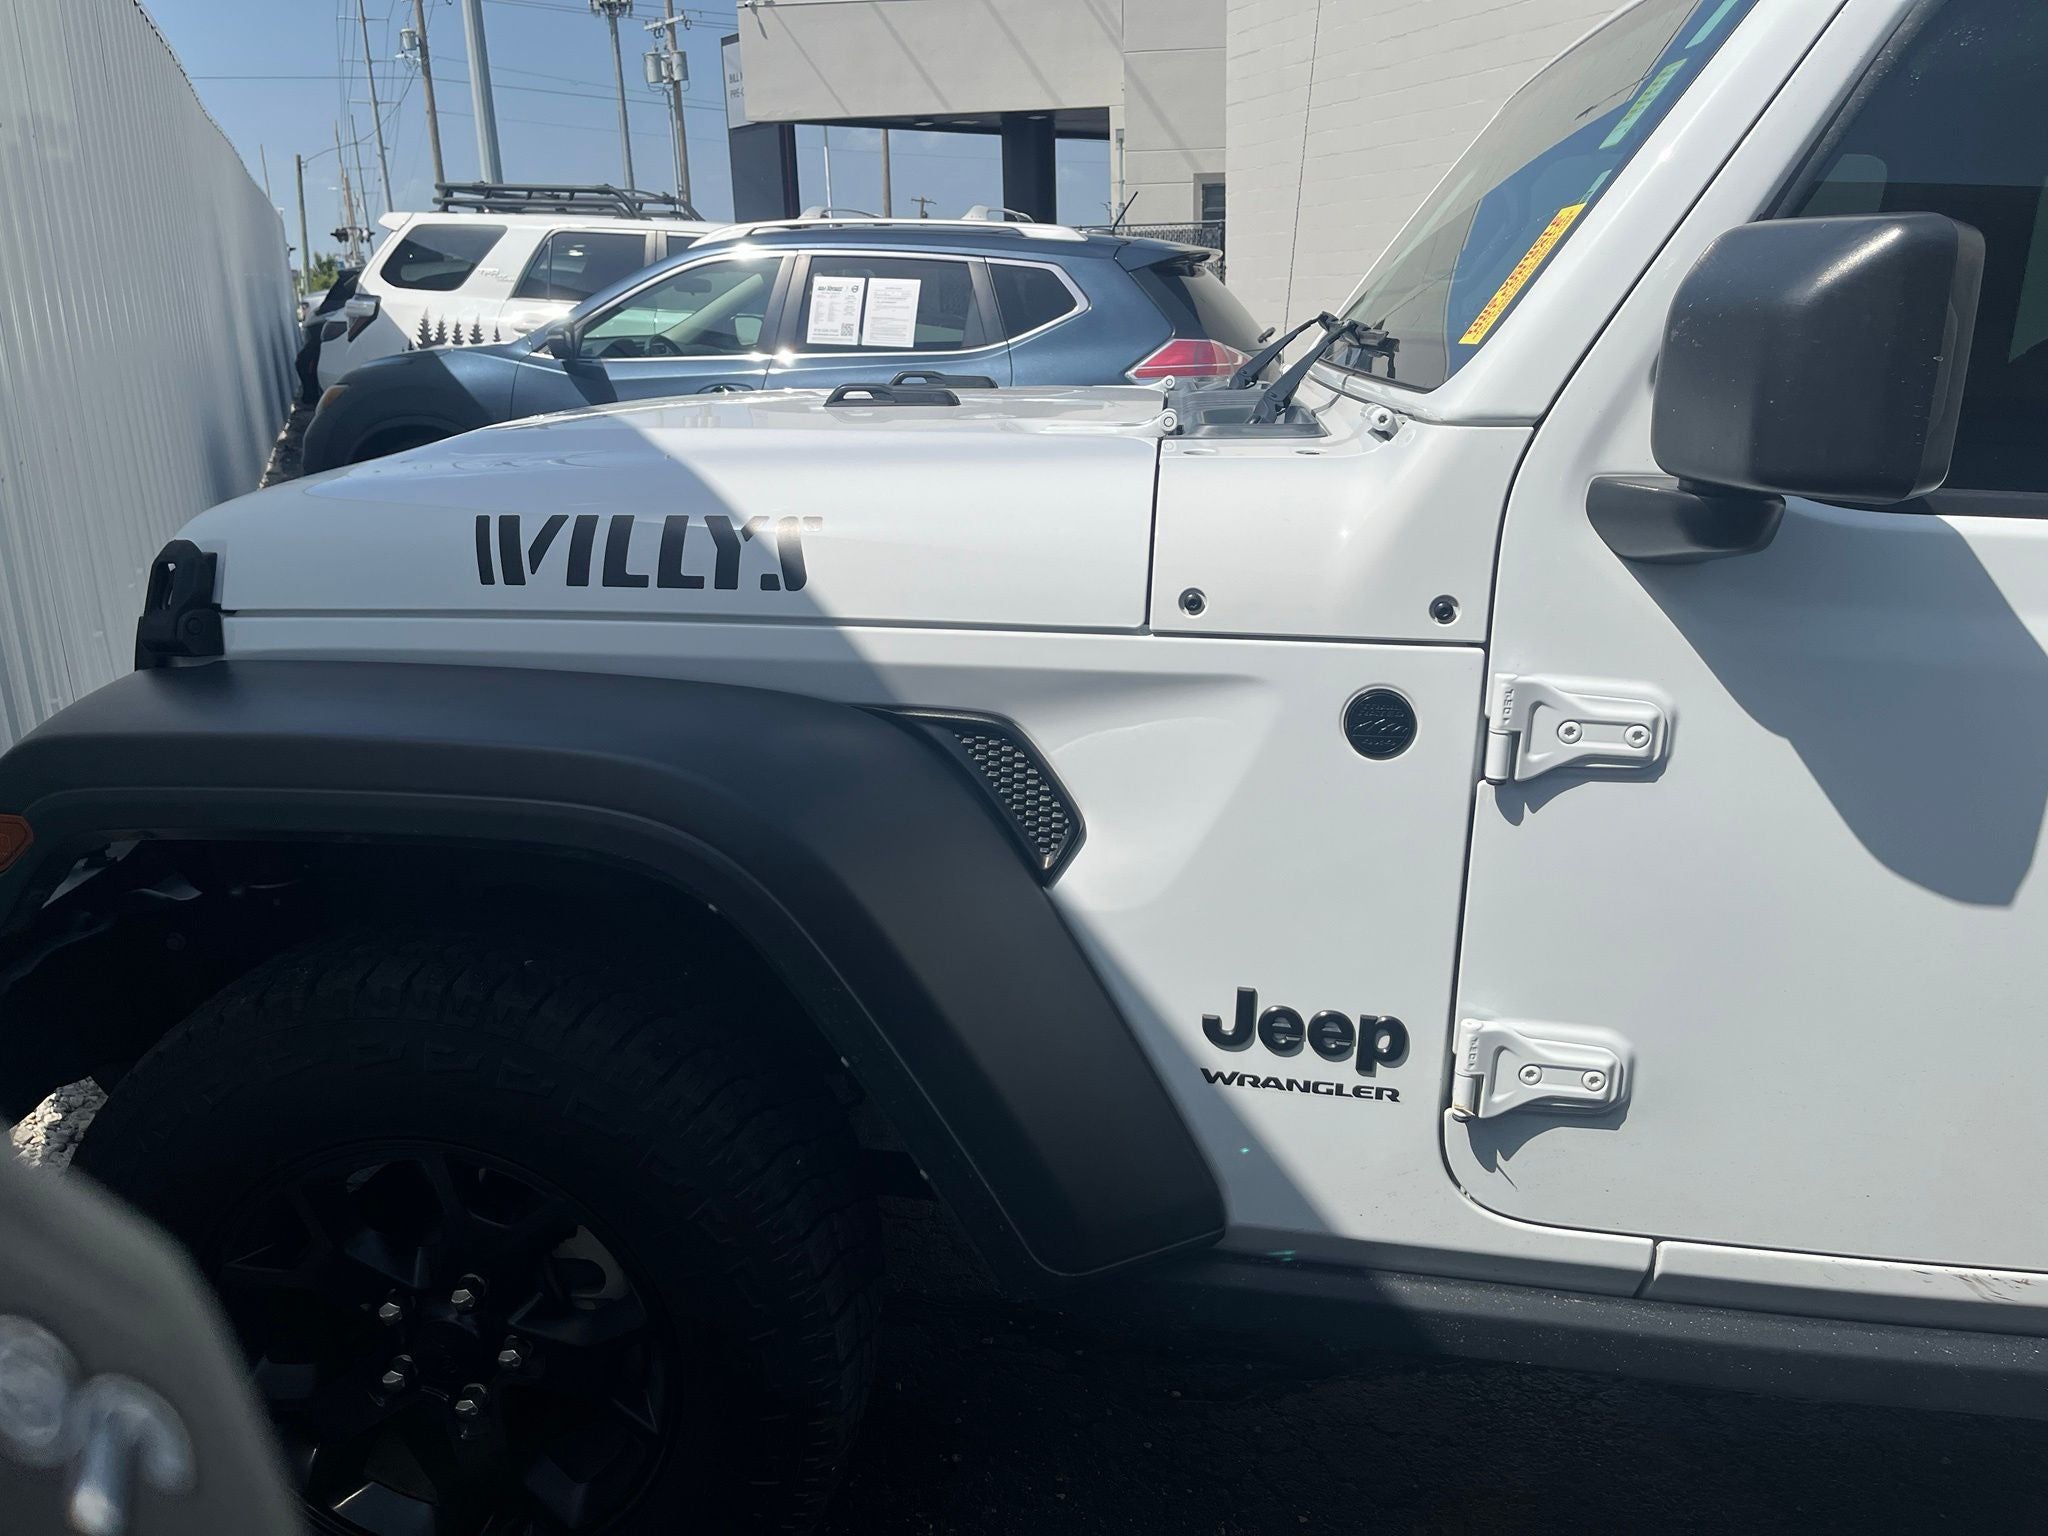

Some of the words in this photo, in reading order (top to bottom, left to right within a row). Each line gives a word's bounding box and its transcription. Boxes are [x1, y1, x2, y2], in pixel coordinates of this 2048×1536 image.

[475, 514, 823, 591] WILLYS
[1202, 986, 1411, 1078] Jeep
[1200, 1067, 1401, 1103] WRANGLER
